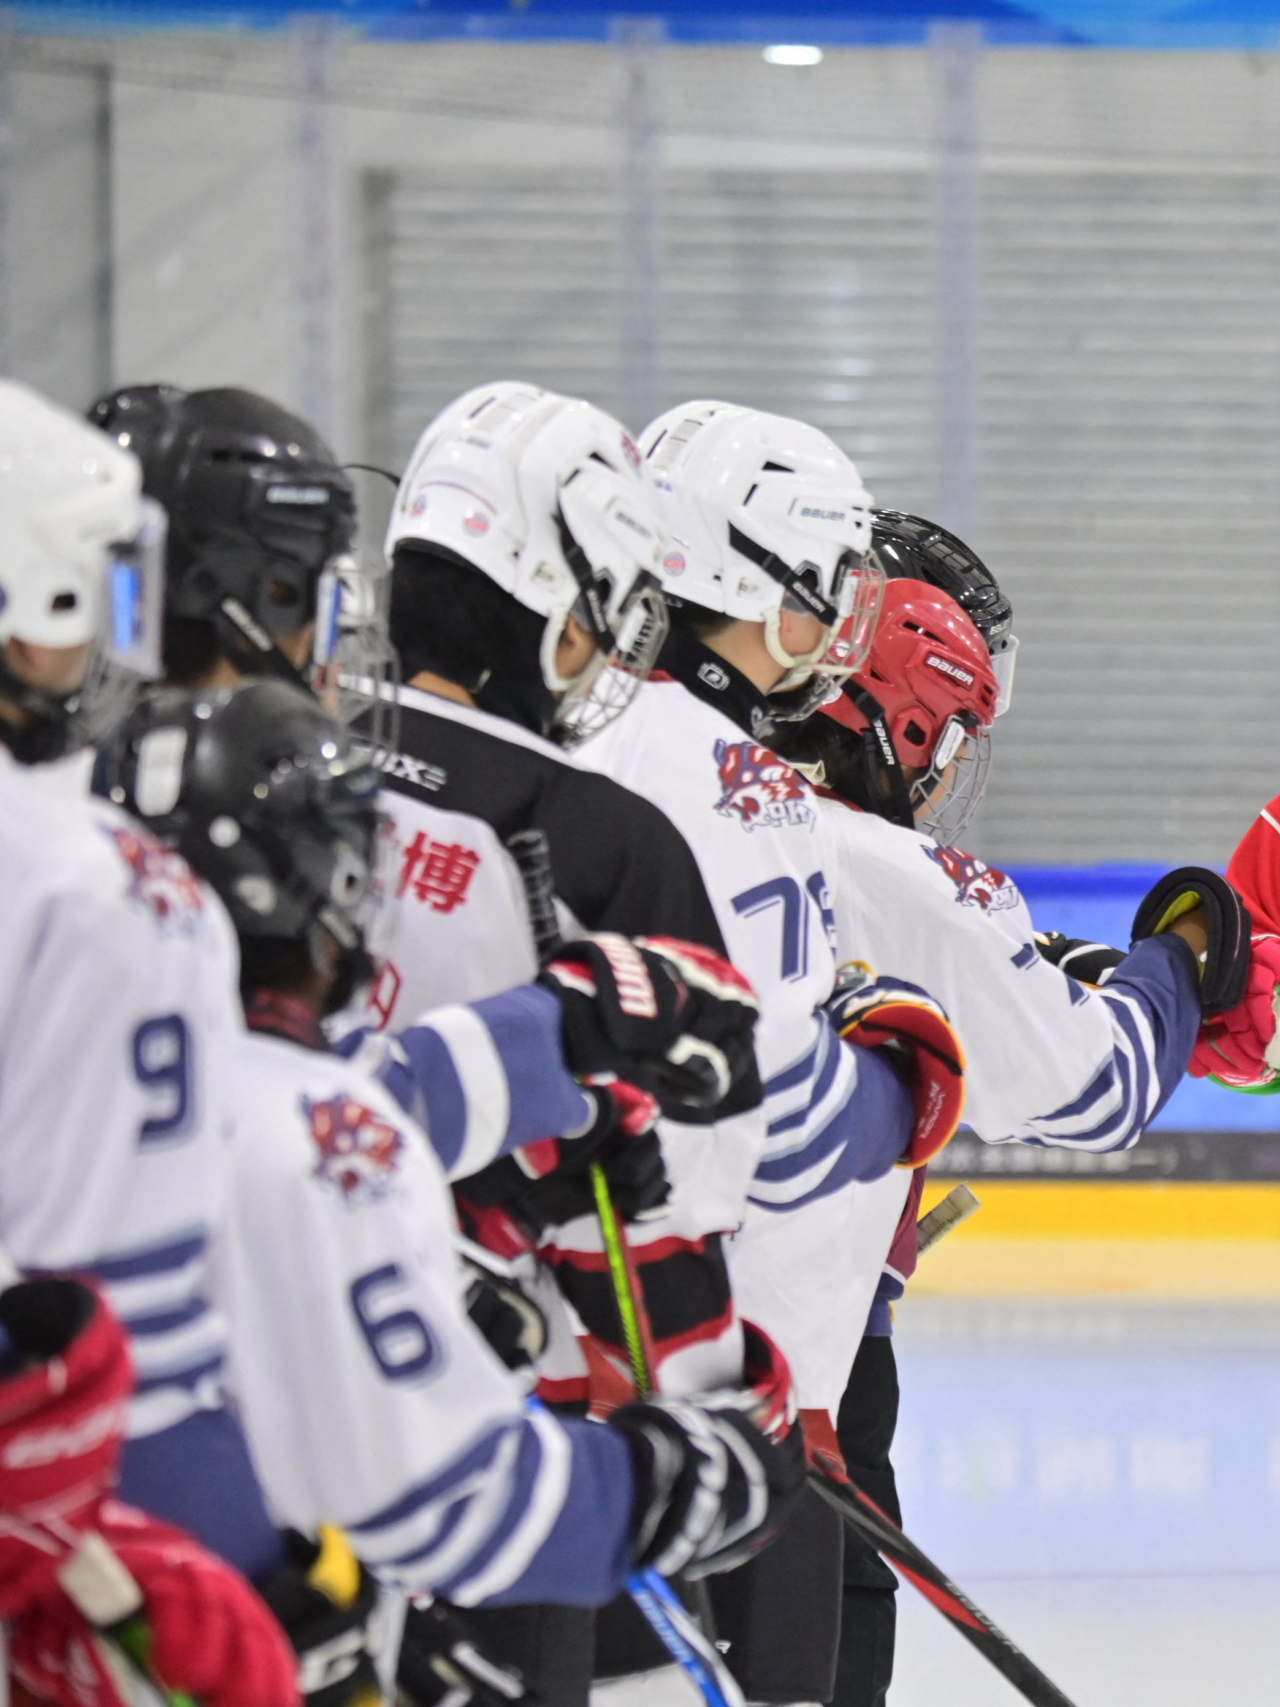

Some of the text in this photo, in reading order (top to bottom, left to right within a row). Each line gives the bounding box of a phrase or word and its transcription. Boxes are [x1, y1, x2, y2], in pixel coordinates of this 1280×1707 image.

[801, 507, 846, 521] BAUER
[926, 656, 974, 686] BAUER
[377, 820, 483, 914] 博
[133, 1013, 191, 1143] 9
[350, 1263, 442, 1383] 6
